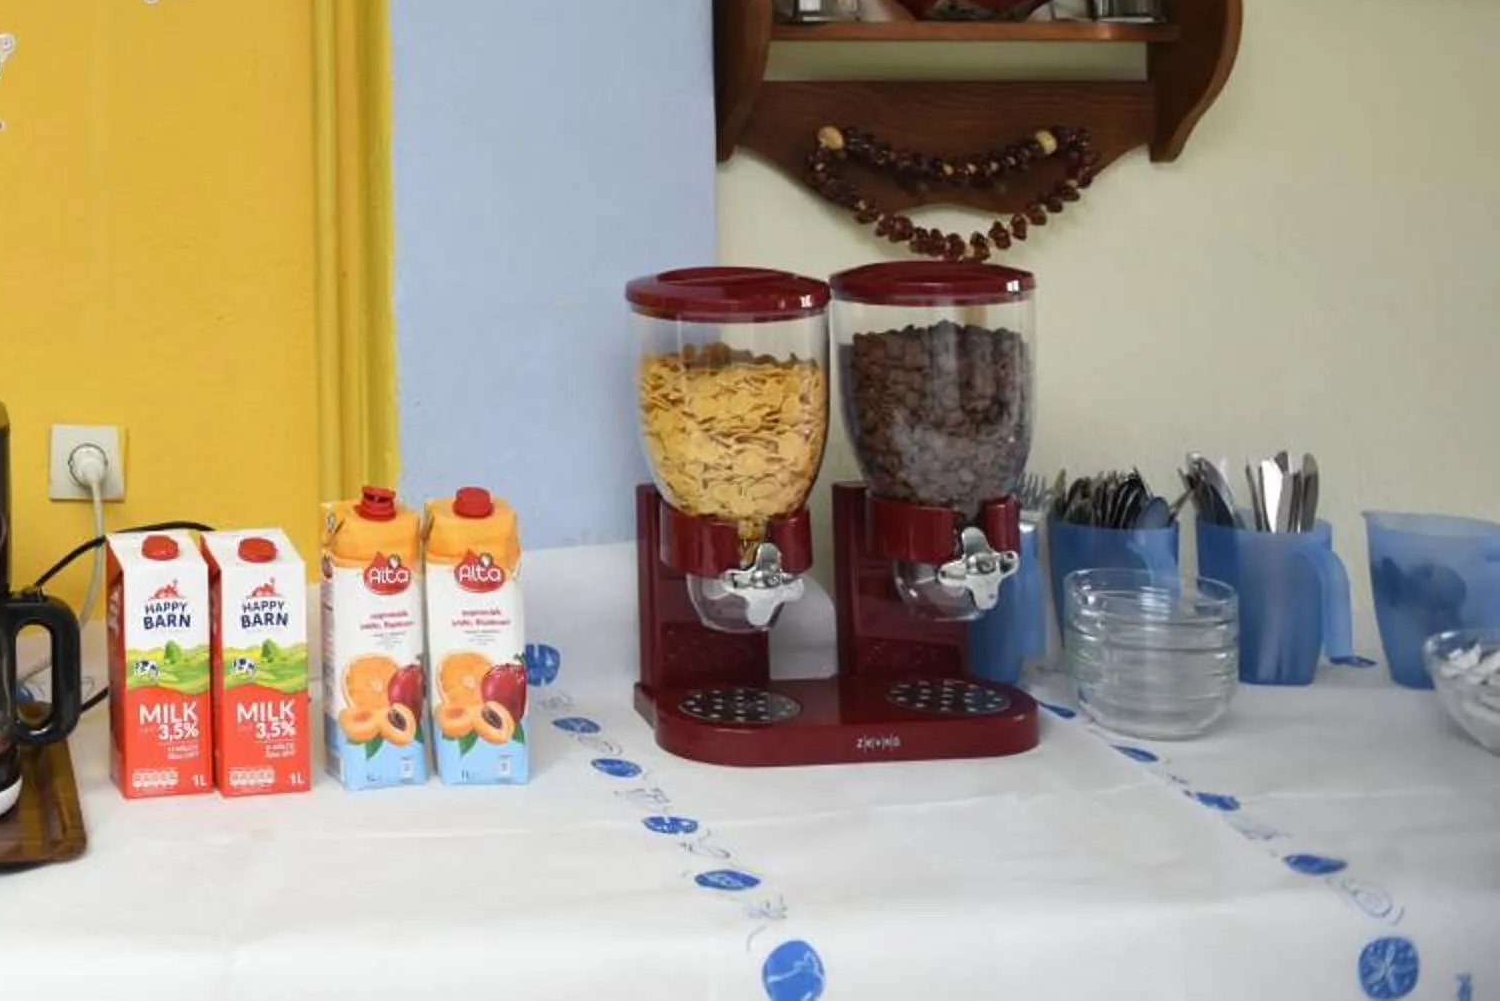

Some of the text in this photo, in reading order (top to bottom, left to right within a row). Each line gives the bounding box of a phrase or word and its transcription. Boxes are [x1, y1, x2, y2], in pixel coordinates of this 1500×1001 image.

[145, 601, 187, 614] HAPPY
[242, 600, 284, 613] HAPPY
[143, 614, 191, 630] BARN
[241, 612, 288, 629] BARN
[139, 701, 198, 725] MILK
[237, 699, 296, 724] MILK
[159, 722, 199, 741] 3,5%
[255, 721, 296, 740] 3,5%
[192, 774, 207, 788] 1L
[290, 772, 305, 786] 1L
